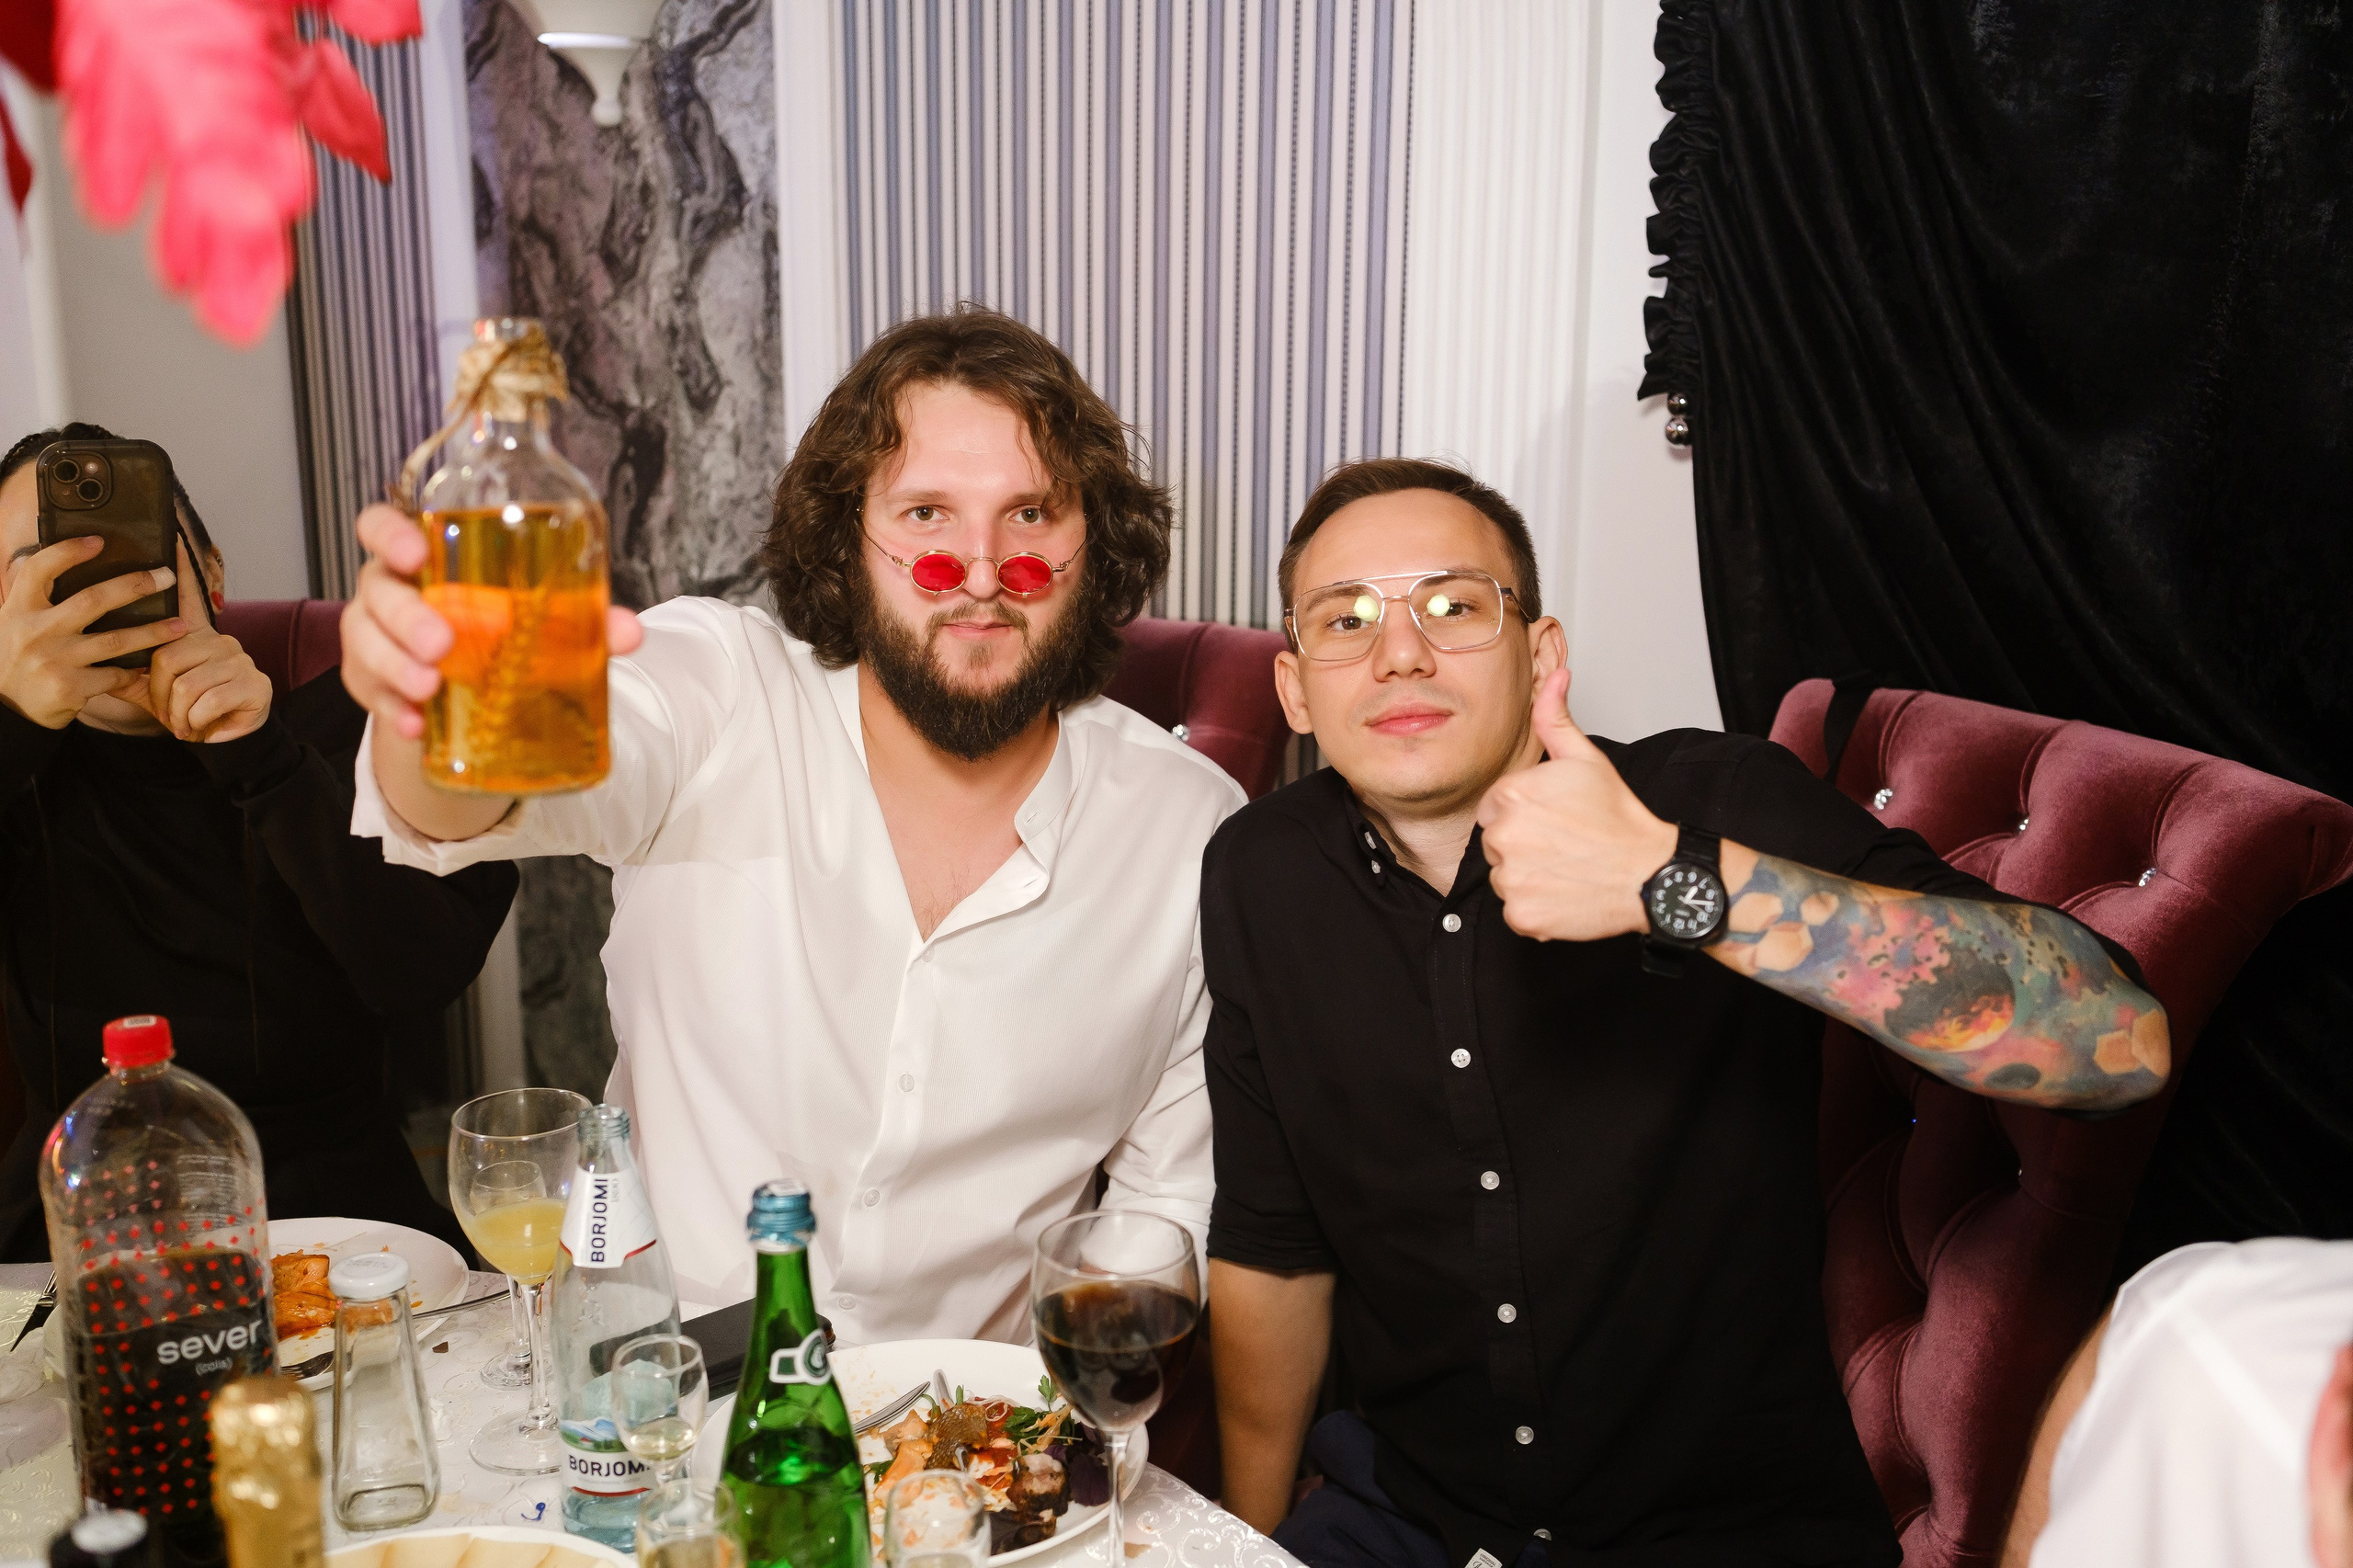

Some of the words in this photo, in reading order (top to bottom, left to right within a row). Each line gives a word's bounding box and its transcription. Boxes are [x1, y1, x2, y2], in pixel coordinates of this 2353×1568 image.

[591, 1179, 608, 1262] BORJOMI
[156, 1318, 262, 1365] sever
[569, 1454, 650, 1477] BORJOM
